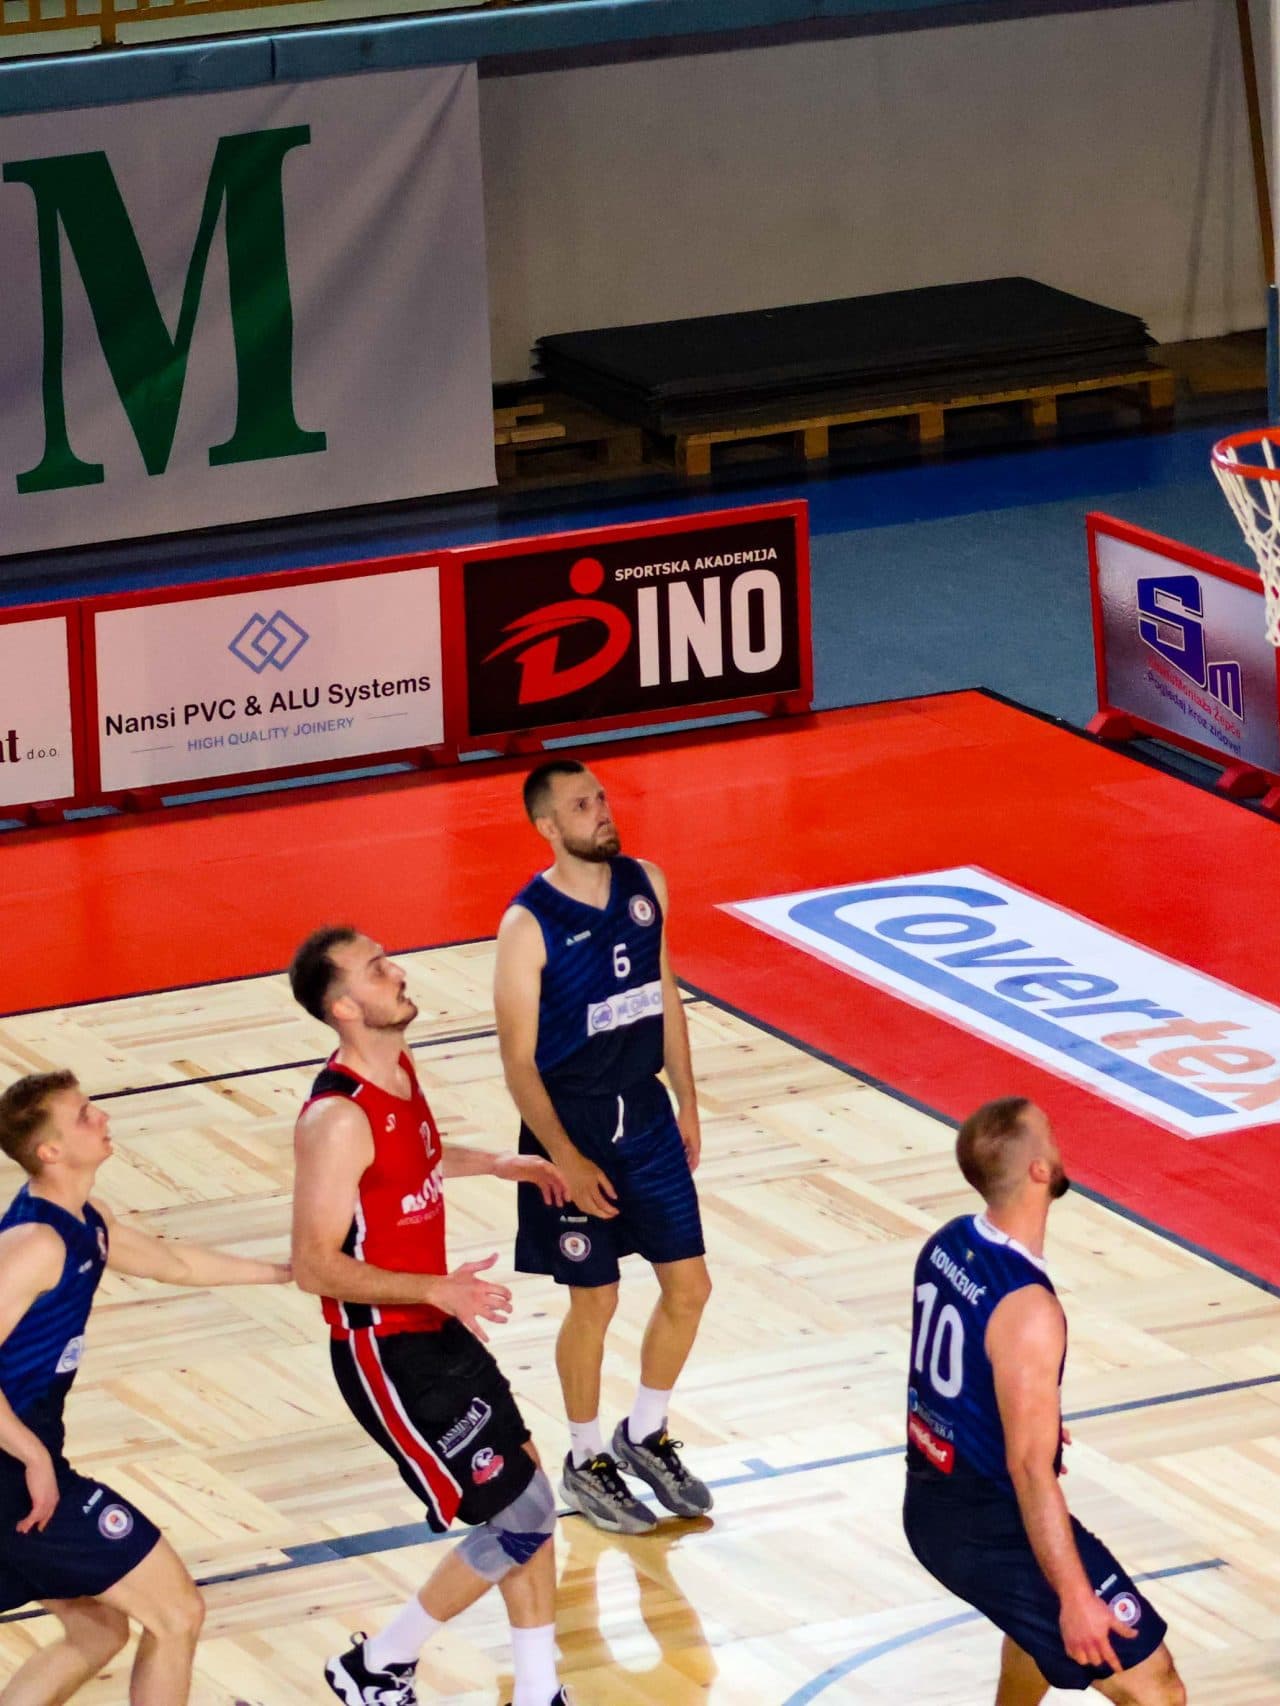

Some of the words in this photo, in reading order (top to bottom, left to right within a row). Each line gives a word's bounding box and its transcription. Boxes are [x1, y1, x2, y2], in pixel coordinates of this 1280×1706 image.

[3, 124, 327, 494] M
[614, 560, 690, 581] SPORTSKA
[694, 548, 777, 570] AKADEMIJA
[105, 707, 176, 736] Nansi
[184, 698, 236, 726] PVC
[245, 695, 263, 717] &
[269, 687, 320, 714] ALU
[328, 675, 432, 708] Systems
[187, 735, 224, 752] HIGH
[228, 727, 290, 746] QUALITY
[293, 717, 355, 738] JOINERY
[613, 942, 631, 978] 6
[916, 1281, 965, 1399] 10
